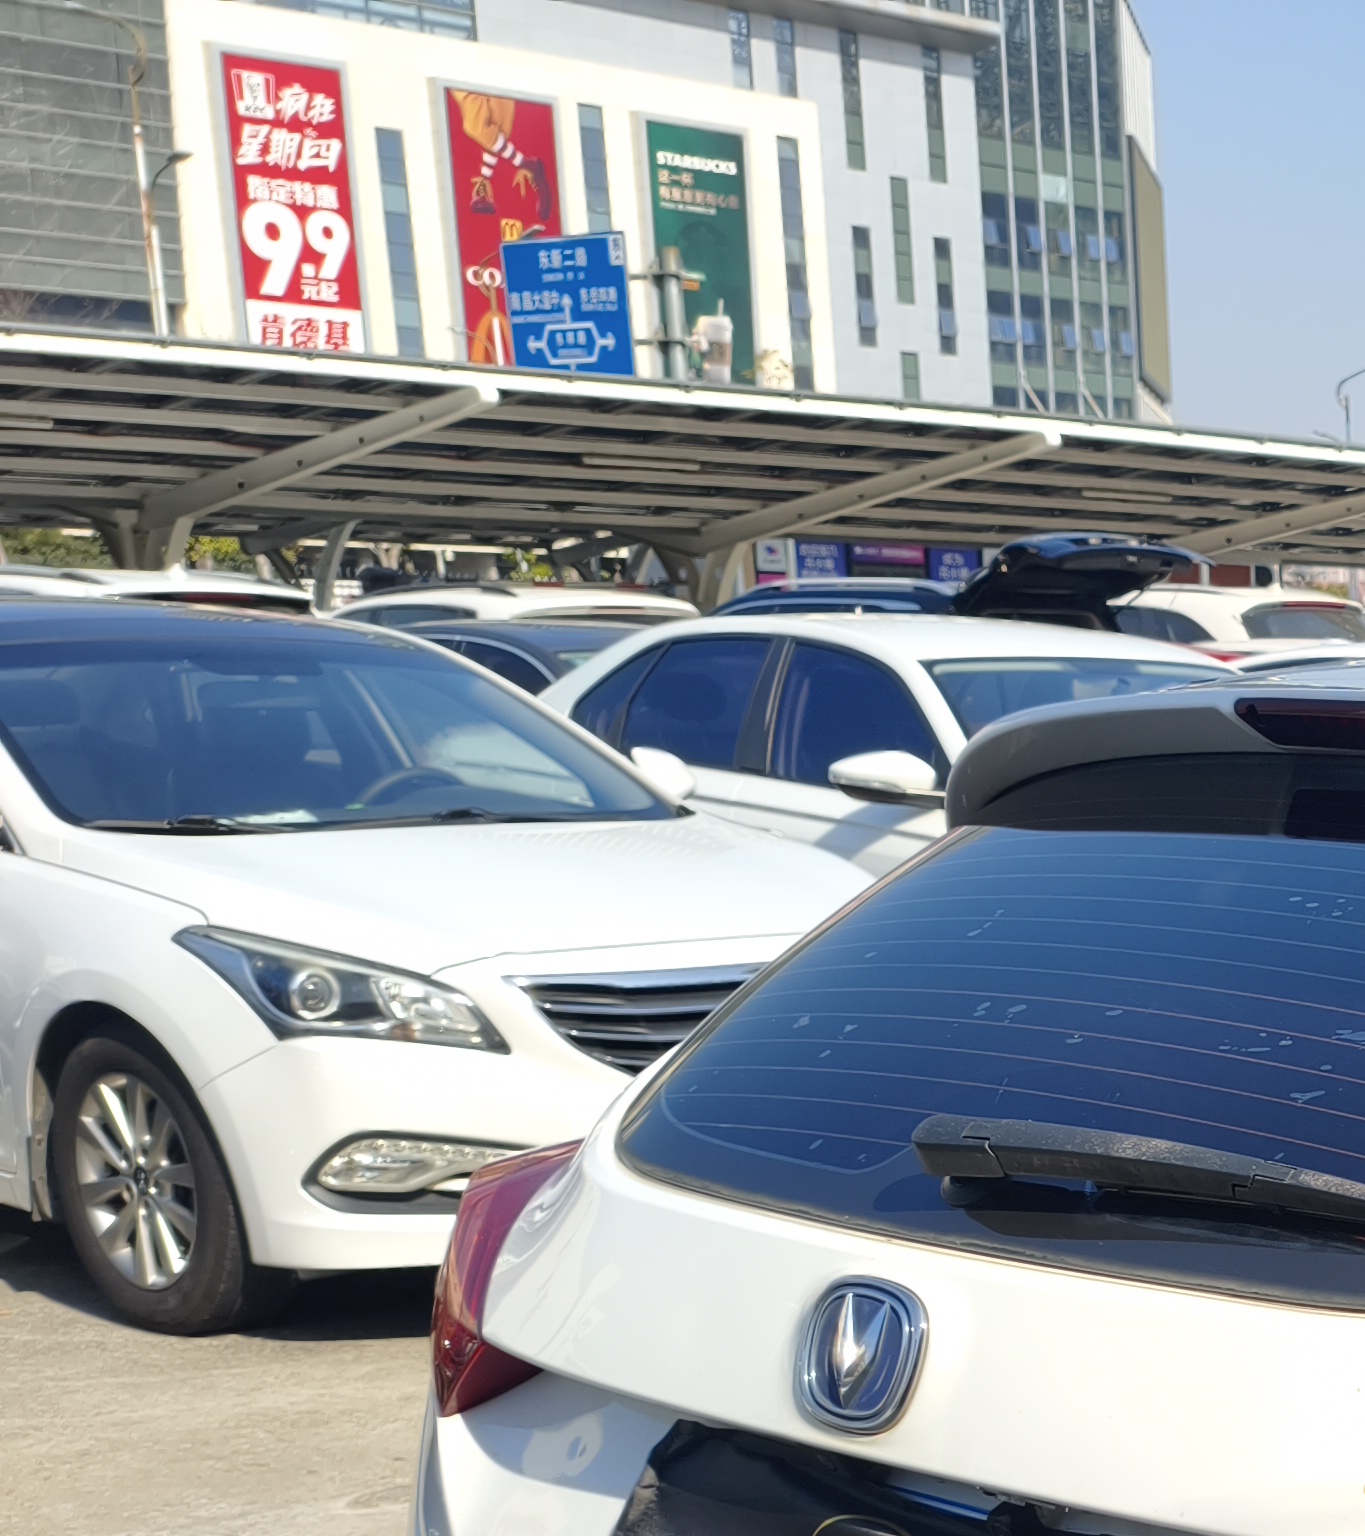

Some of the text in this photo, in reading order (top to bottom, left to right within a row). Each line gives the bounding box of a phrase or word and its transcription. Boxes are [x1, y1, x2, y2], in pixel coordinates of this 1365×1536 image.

[276, 83, 336, 125] 疯狂
[236, 123, 342, 173] 星期四
[300, 279, 340, 303] 元起
[466, 265, 505, 288] CO
[260, 314, 350, 351] 肯德基
